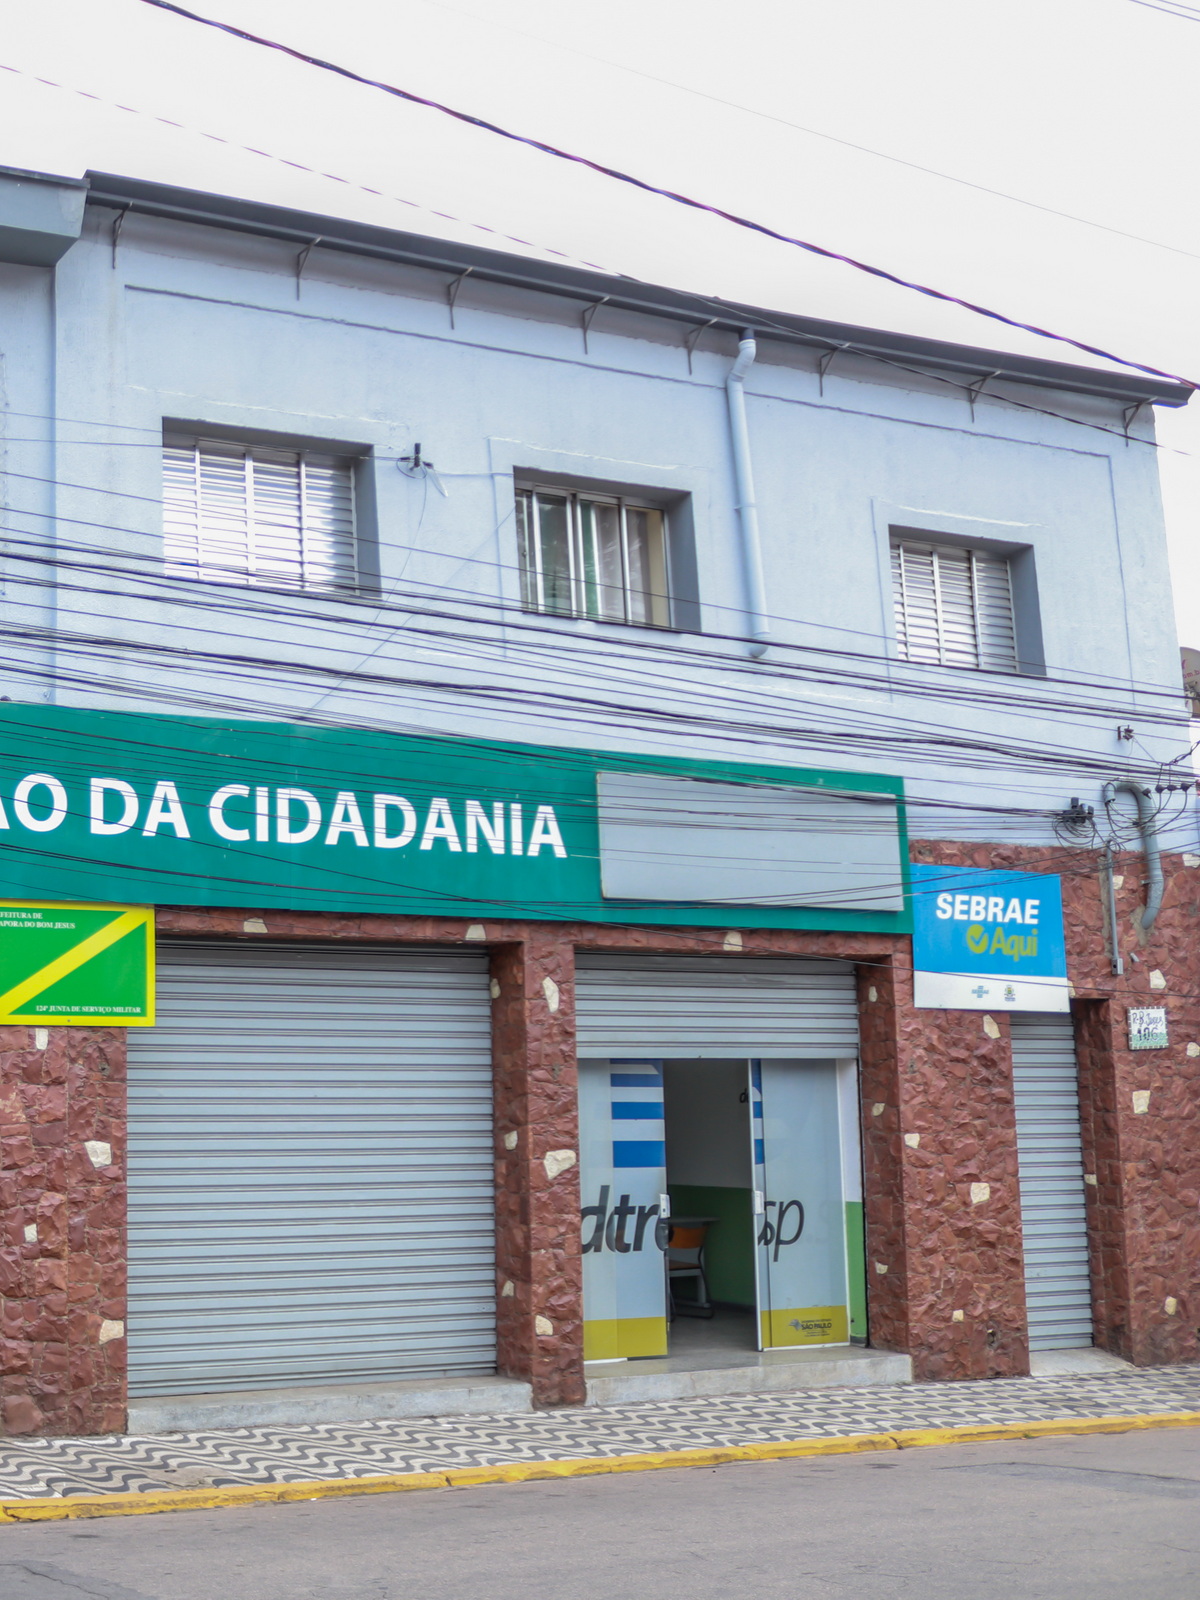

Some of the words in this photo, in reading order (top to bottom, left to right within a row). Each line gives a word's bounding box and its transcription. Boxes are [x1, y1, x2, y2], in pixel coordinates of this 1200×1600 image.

[91, 777, 191, 838] DA
[210, 784, 568, 858] CIDADANIA
[32, 912, 43, 920] DE
[936, 893, 1040, 925] SEBRAE
[36, 921, 53, 929] BOM
[54, 922, 76, 930] JESUS
[989, 929, 1039, 962] Aqui
[81, 1006, 111, 1014] SERVIÇO
